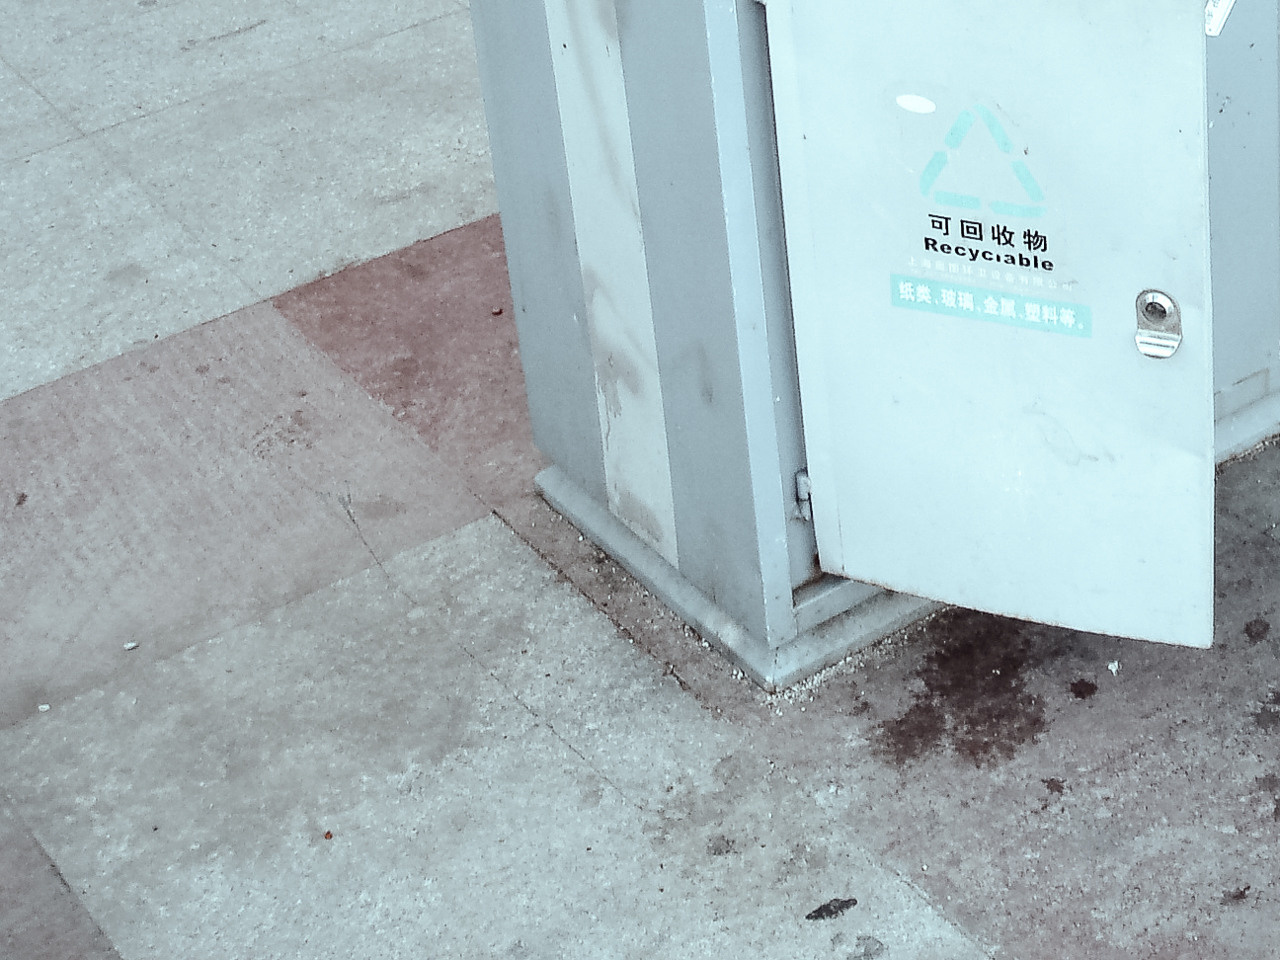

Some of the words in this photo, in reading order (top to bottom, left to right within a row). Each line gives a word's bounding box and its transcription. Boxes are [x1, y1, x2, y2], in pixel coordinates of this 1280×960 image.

[928, 213, 1048, 252] 可回收物
[924, 237, 1055, 271] Recyclable
